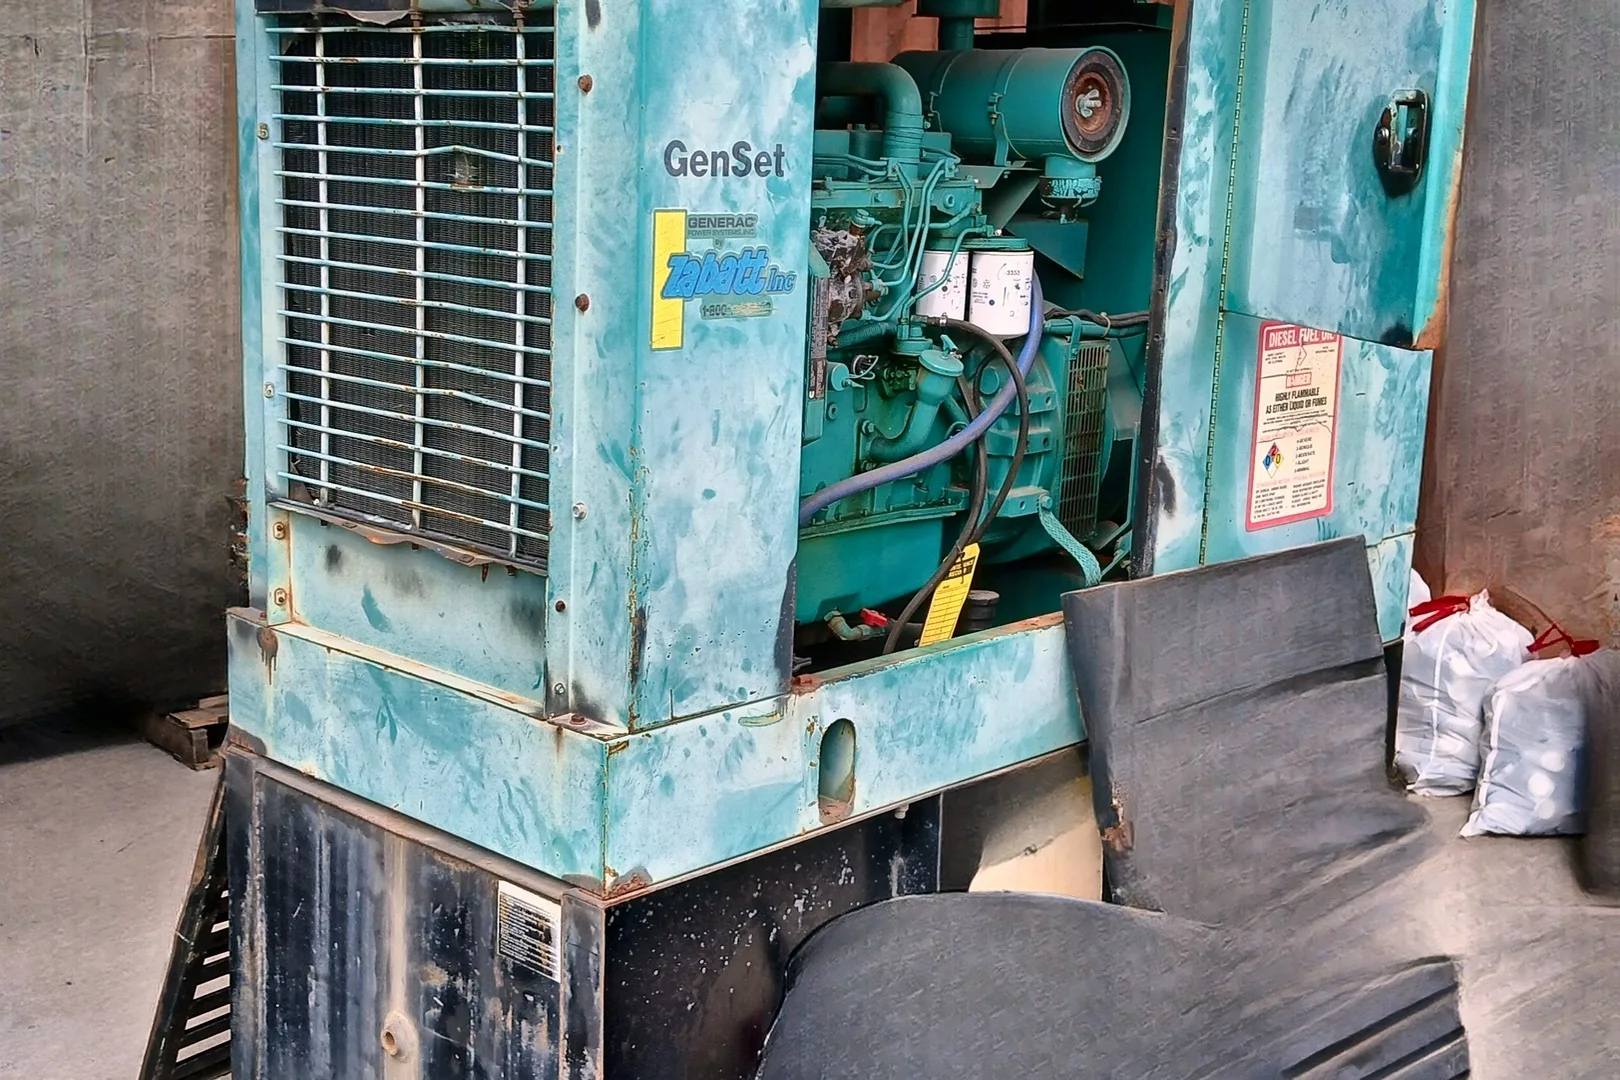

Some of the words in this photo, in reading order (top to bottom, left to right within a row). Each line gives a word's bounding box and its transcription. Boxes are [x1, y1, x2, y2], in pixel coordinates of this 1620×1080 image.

[663, 139, 785, 178] GenSet
[688, 217, 755, 229] GENERAC
[687, 229, 711, 237] POWER
[661, 249, 769, 299] Zabatt
[767, 268, 796, 291] Inc
[1269, 329, 1297, 348] DIESEL
[1299, 327, 1320, 344] FUEL
[1274, 391, 1291, 402] HIGHLY
[1291, 387, 1320, 400] FLAMMABLE
[1265, 404, 1272, 415] AS
[1272, 402, 1289, 413] EITHER
[1289, 399, 1304, 411] LIQUID
[1305, 398, 1312, 409] OR
[1312, 396, 1328, 407] FUMES
[1271, 445, 1278, 457] 2
[1265, 455, 1271, 467] 0
[1275, 453, 1281, 464] 0
